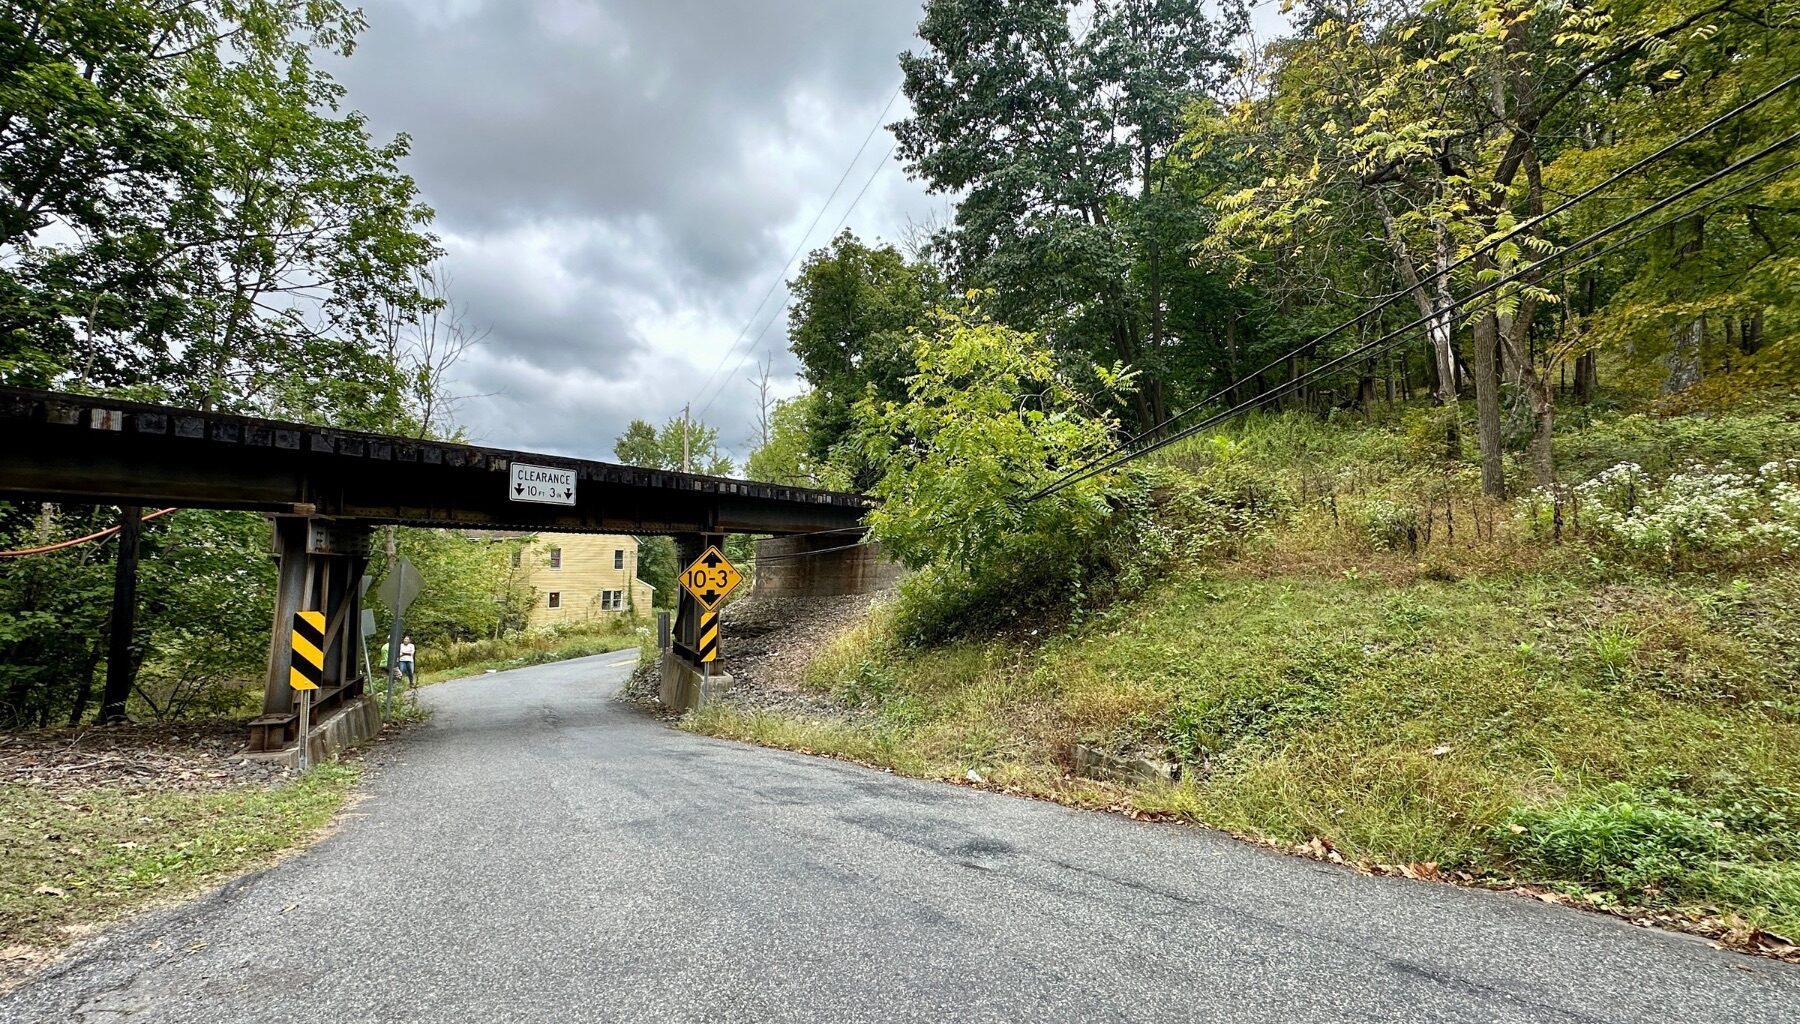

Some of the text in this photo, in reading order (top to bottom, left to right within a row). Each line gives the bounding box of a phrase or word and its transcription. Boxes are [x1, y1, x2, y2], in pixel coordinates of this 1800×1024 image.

[518, 470, 570, 485] CLEARANCE
[527, 485, 537, 496] 10
[549, 487, 555, 498] 3
